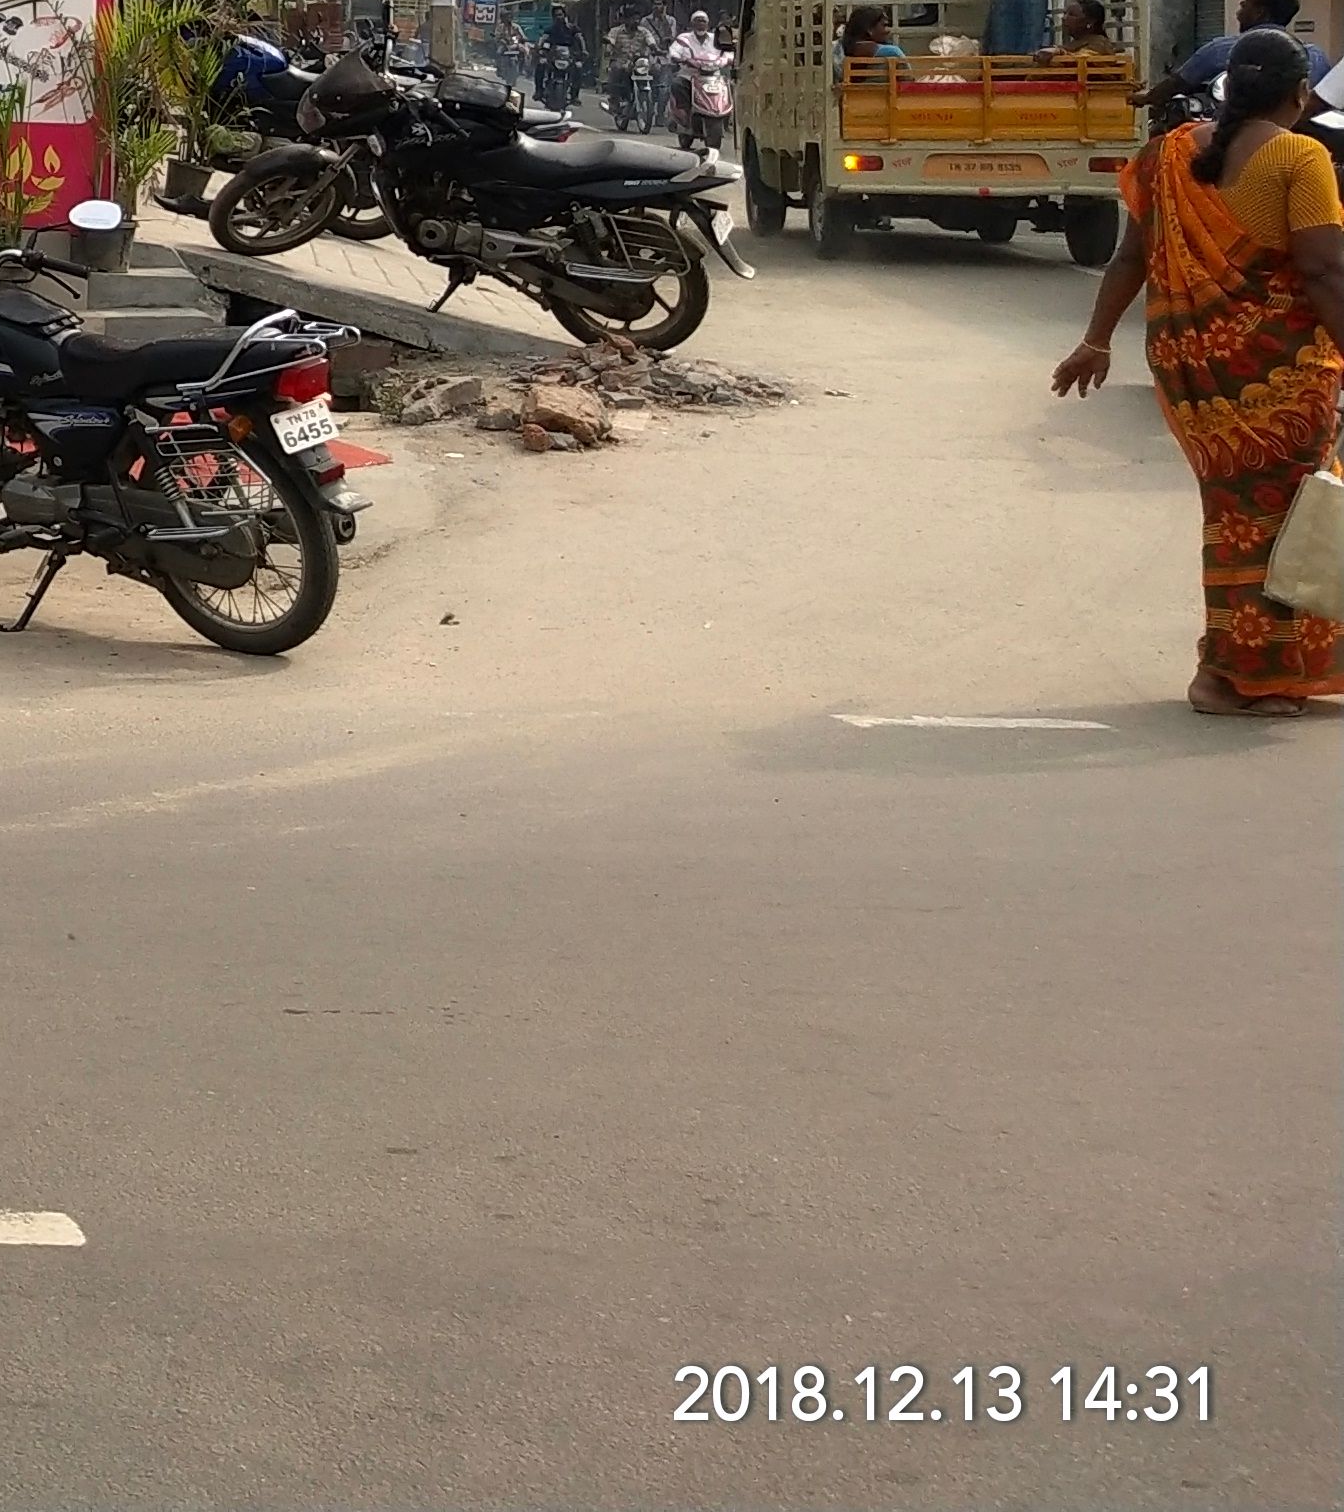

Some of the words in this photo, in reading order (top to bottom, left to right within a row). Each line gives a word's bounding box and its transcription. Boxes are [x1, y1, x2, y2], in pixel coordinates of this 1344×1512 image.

[286, 413, 302, 426] TN
[303, 408, 317, 420] 78
[283, 417, 333, 448] 6455
